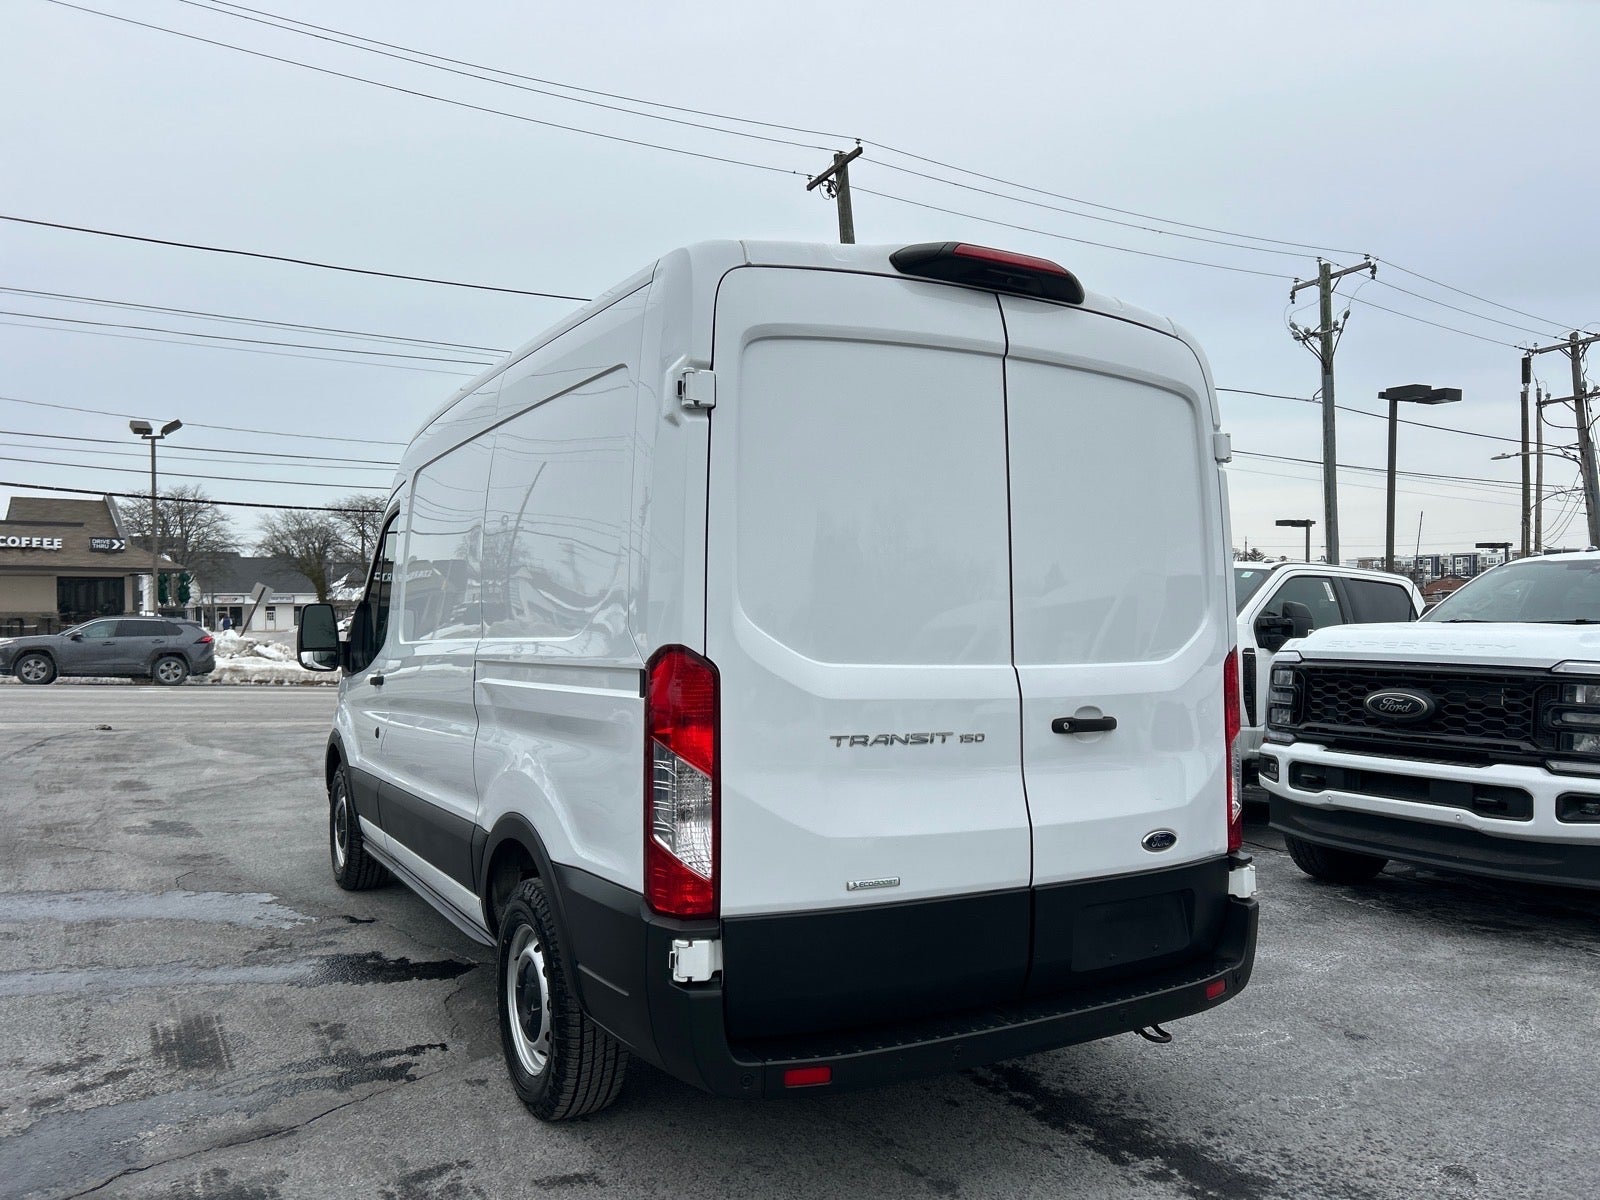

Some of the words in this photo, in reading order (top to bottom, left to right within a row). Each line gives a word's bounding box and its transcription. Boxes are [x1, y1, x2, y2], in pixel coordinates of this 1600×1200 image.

[0, 535, 63, 550] COFFEE
[1379, 697, 1412, 713] Ford
[829, 731, 954, 748] TRANSIT
[959, 733, 985, 744] 150
[858, 879, 897, 888] ECOBOOST
